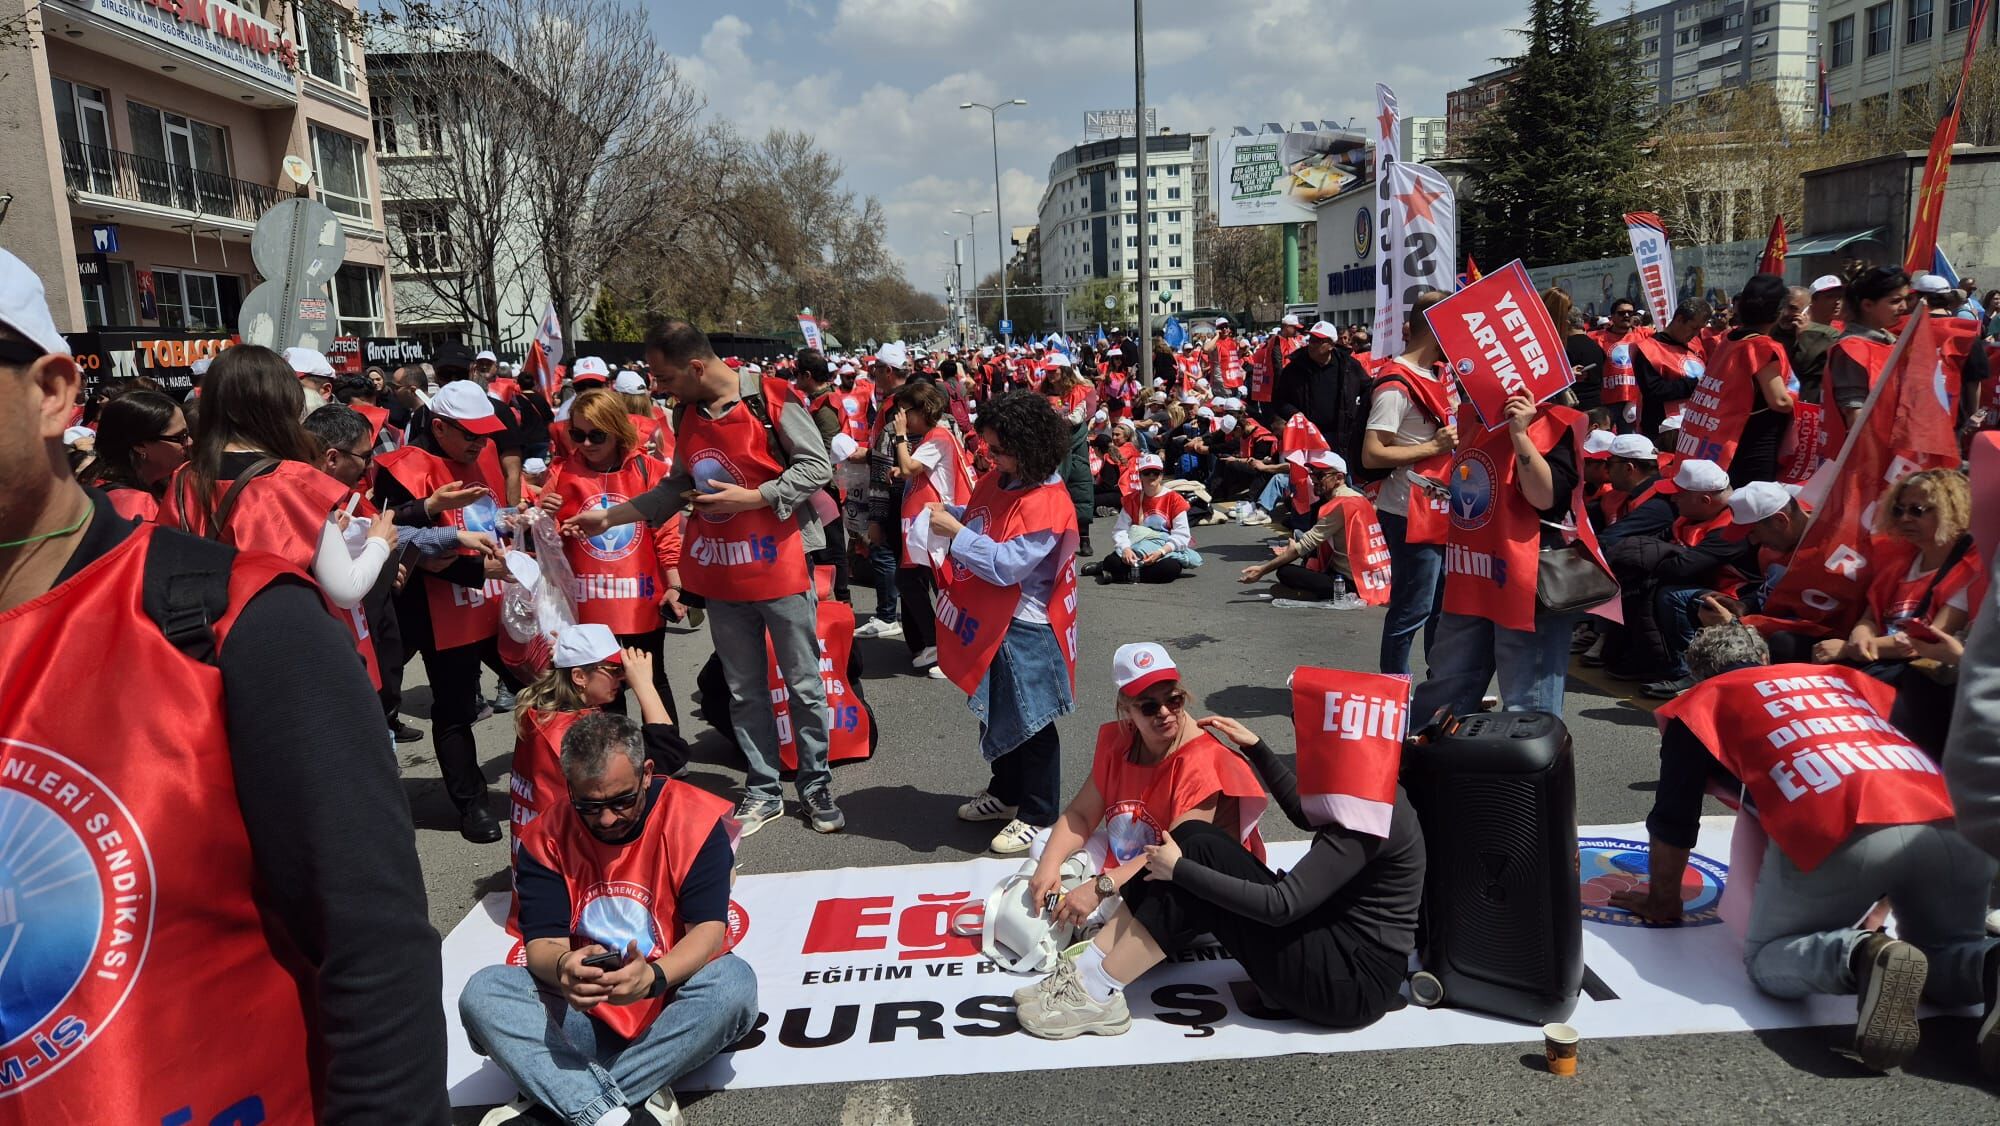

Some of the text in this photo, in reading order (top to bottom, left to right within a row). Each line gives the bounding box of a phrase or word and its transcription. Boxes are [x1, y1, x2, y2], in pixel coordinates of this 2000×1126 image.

[137, 12, 159, 30] KAMU
[1495, 290, 1549, 380] YETER
[1754, 675, 1855, 697] EMEK
[1769, 741, 1939, 802] Eğitim
[86, 811, 144, 981] SENDİKASI
[802, 962, 912, 986] EĞİTİM
[925, 962, 963, 978] VE
